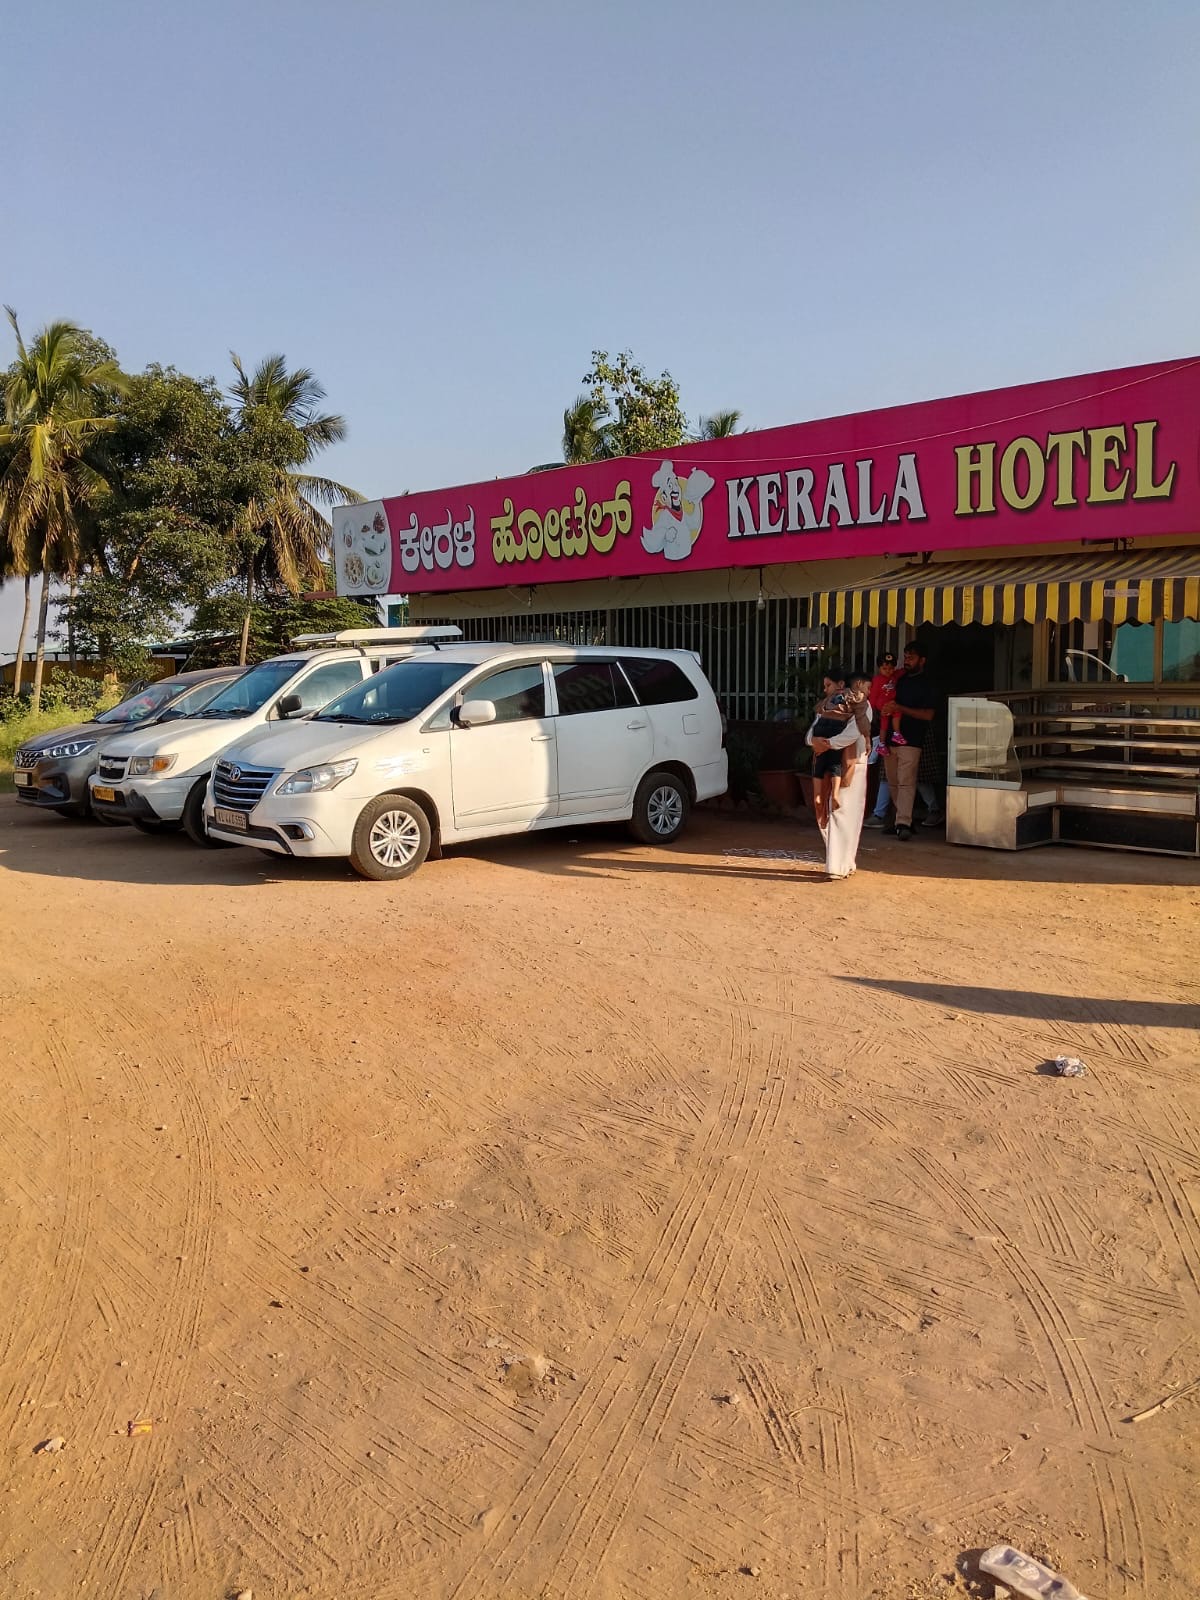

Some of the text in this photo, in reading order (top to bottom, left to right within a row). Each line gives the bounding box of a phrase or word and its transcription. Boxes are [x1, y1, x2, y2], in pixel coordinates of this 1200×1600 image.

[726, 421, 1176, 538] KERALA HOTEL
[399, 504, 475, 572] ಕೇರಳ
